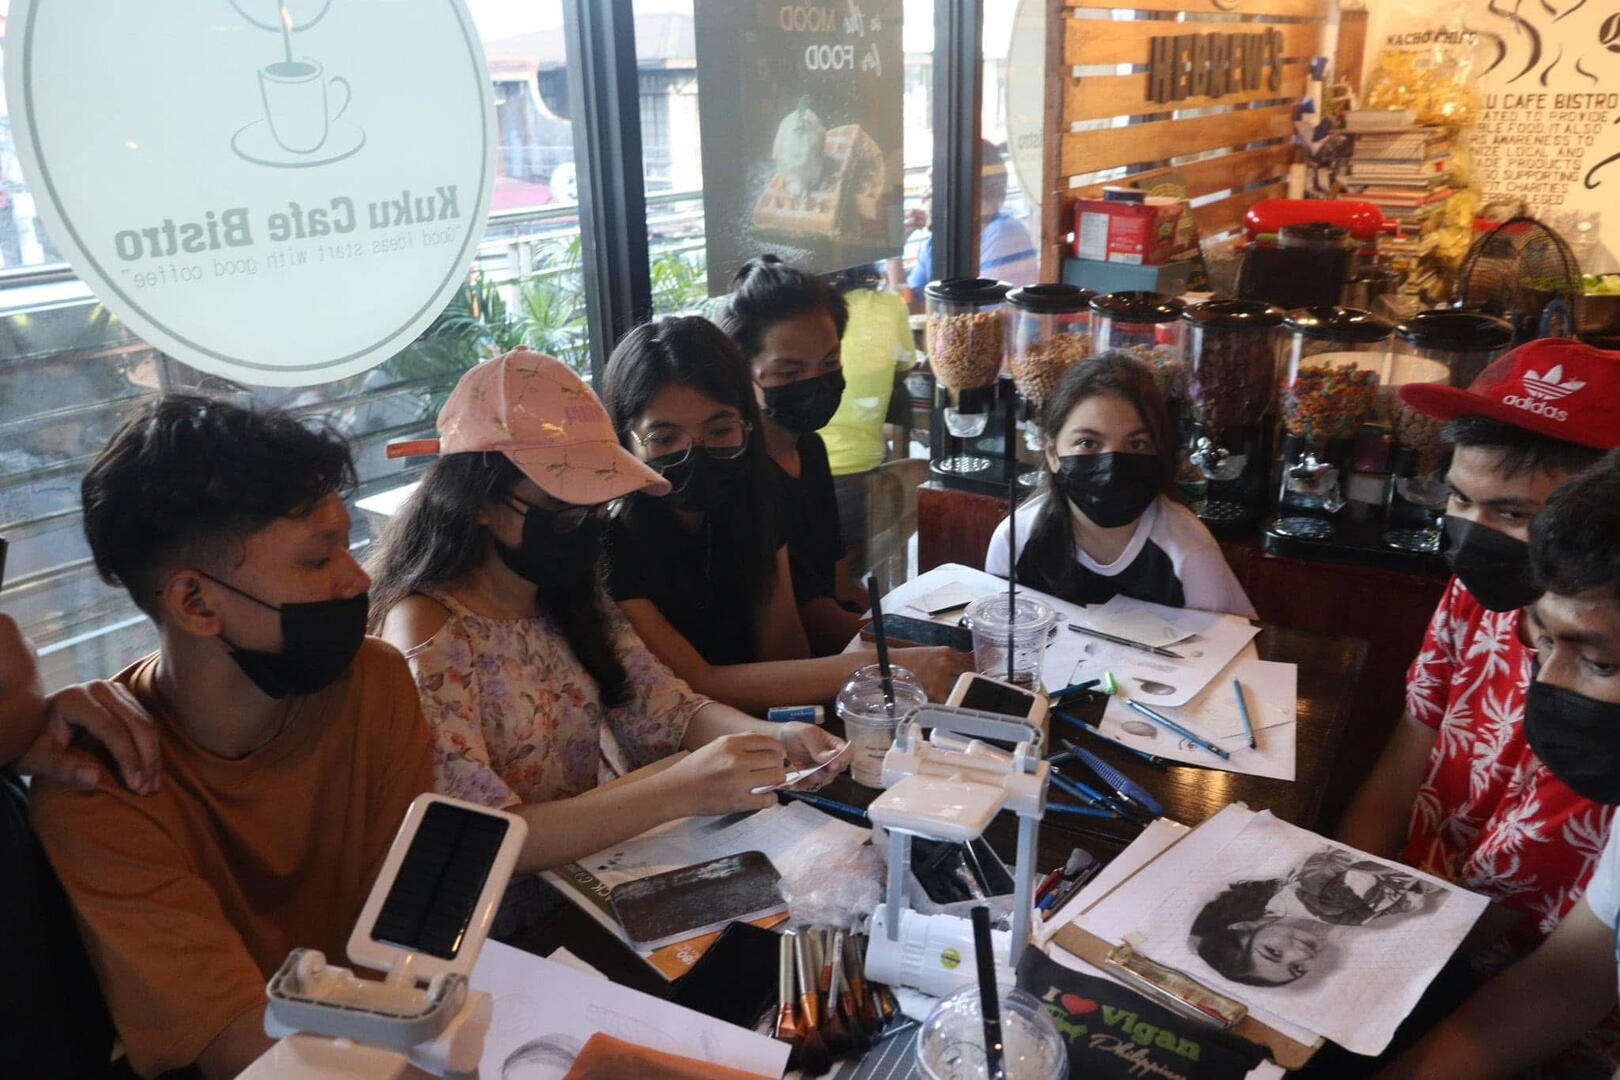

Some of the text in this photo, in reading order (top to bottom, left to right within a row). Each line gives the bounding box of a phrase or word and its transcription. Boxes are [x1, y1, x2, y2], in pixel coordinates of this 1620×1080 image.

[1503, 93, 1547, 109] CAFE
[1554, 92, 1619, 109] BISTRO
[1525, 111, 1542, 121] TO
[1549, 111, 1609, 122] PROVIDE
[1564, 123, 1602, 134] ALSO
[1492, 134, 1571, 146] AWARENESS
[1578, 135, 1594, 146] TO
[1507, 146, 1548, 157] LOCAL
[1558, 147, 1584, 158] AND
[1508, 159, 1582, 170] PRODUCTS
[1503, 169, 1579, 182] SUPPORTING
[1505, 181, 1569, 193] CHARITIES
[1502, 394, 1568, 422] adidas
[1101, 1004, 1201, 1061] Vigan
